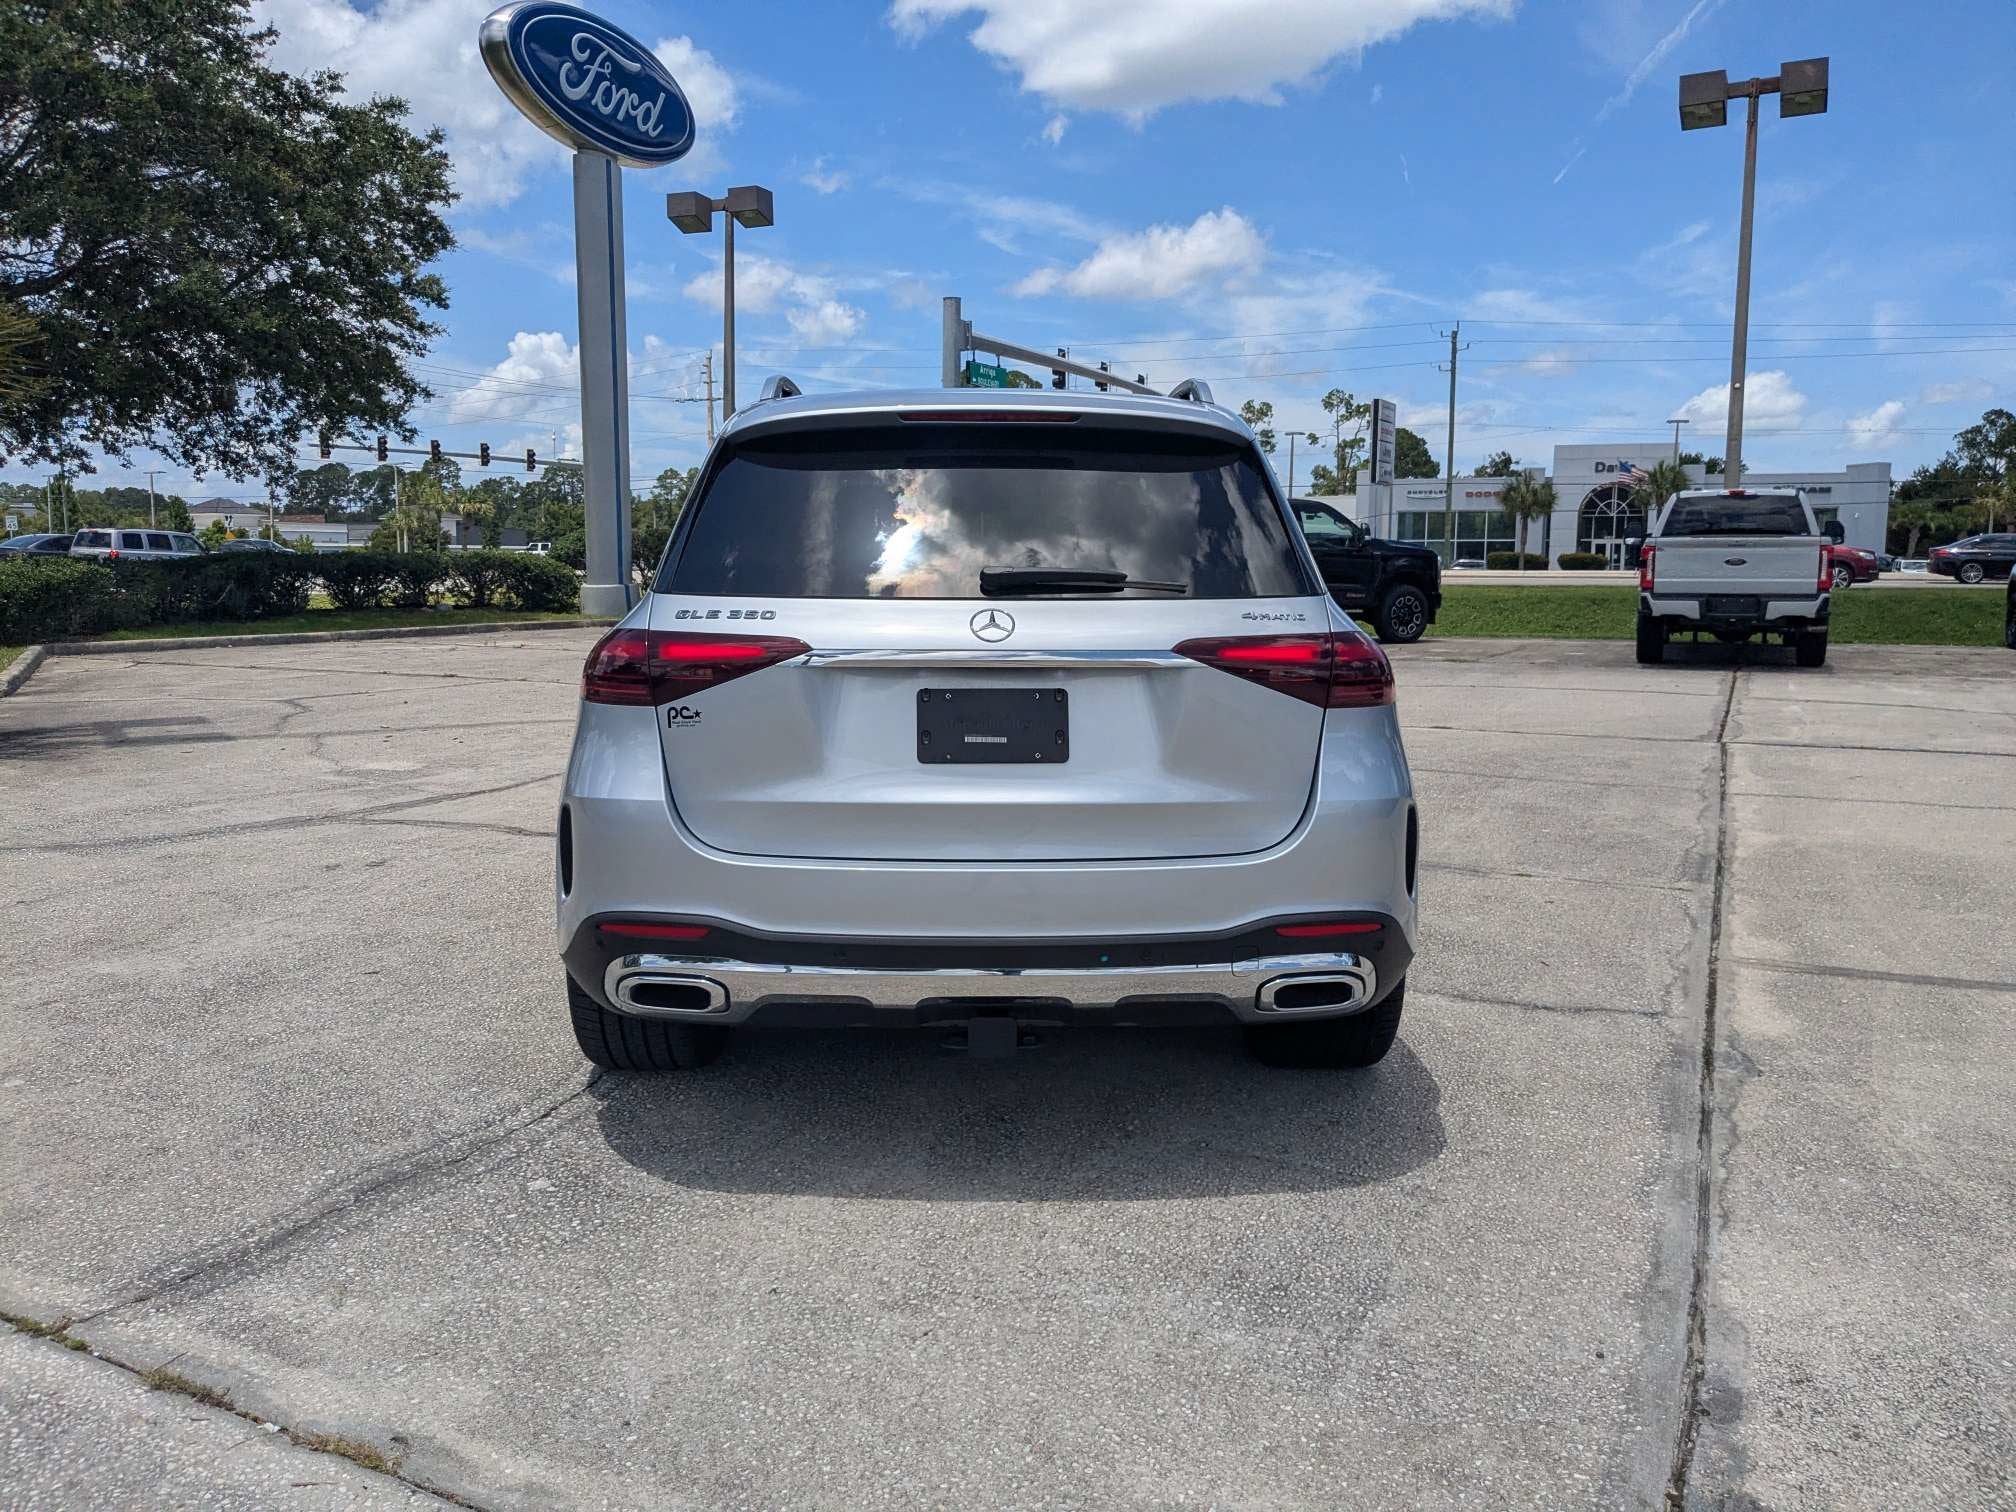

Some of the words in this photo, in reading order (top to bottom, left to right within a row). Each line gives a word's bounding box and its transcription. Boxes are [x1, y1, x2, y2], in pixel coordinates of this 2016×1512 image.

[560, 32, 666, 137] Ford
[675, 609, 722, 620] GLE
[726, 609, 777, 621] 350
